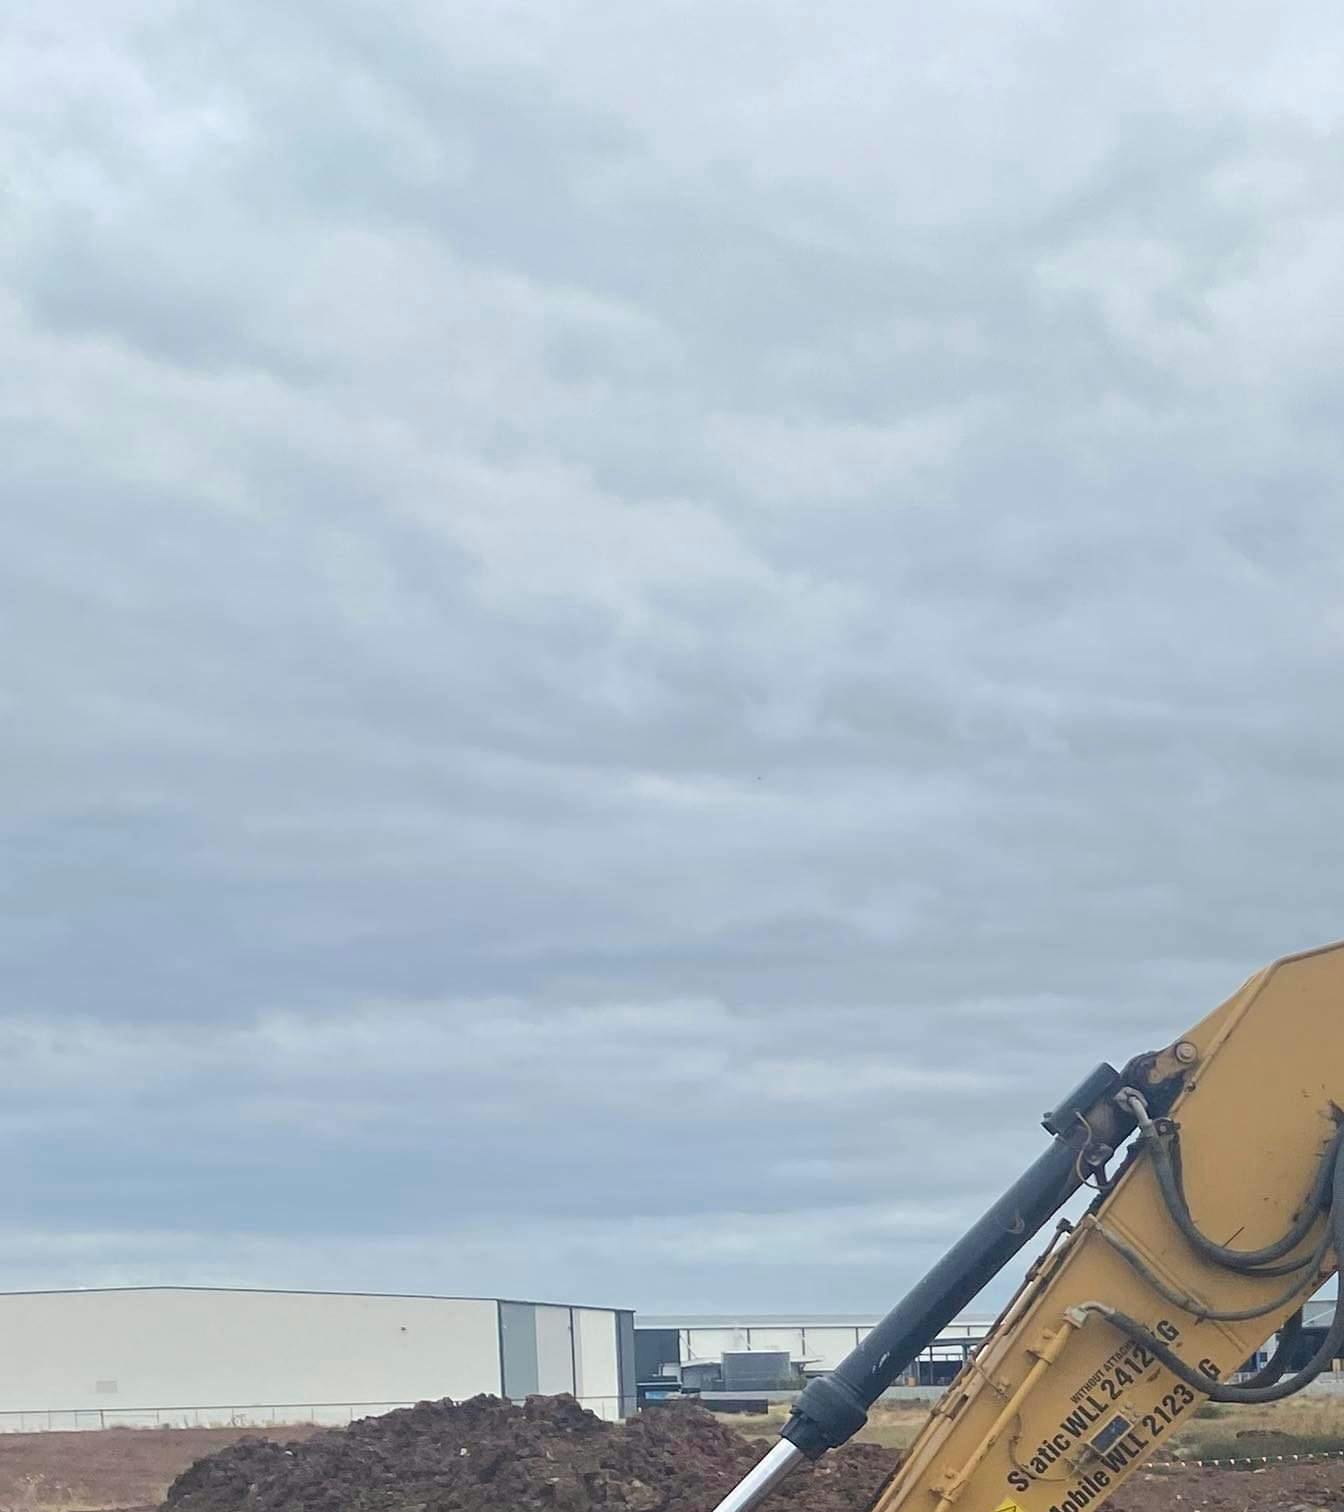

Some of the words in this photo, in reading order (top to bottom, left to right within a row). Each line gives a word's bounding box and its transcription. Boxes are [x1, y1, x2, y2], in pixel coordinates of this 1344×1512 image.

[1007, 1433, 1071, 1492] Satic
[1060, 1395, 1109, 1438] WLL
[1101, 1343, 1155, 1400] 2412
[1071, 1368, 1105, 1404] WITHOUT
[1101, 1432, 1149, 1474] WLL
[1142, 1383, 1195, 1437] 2123
[1198, 1358, 1222, 1381] G
